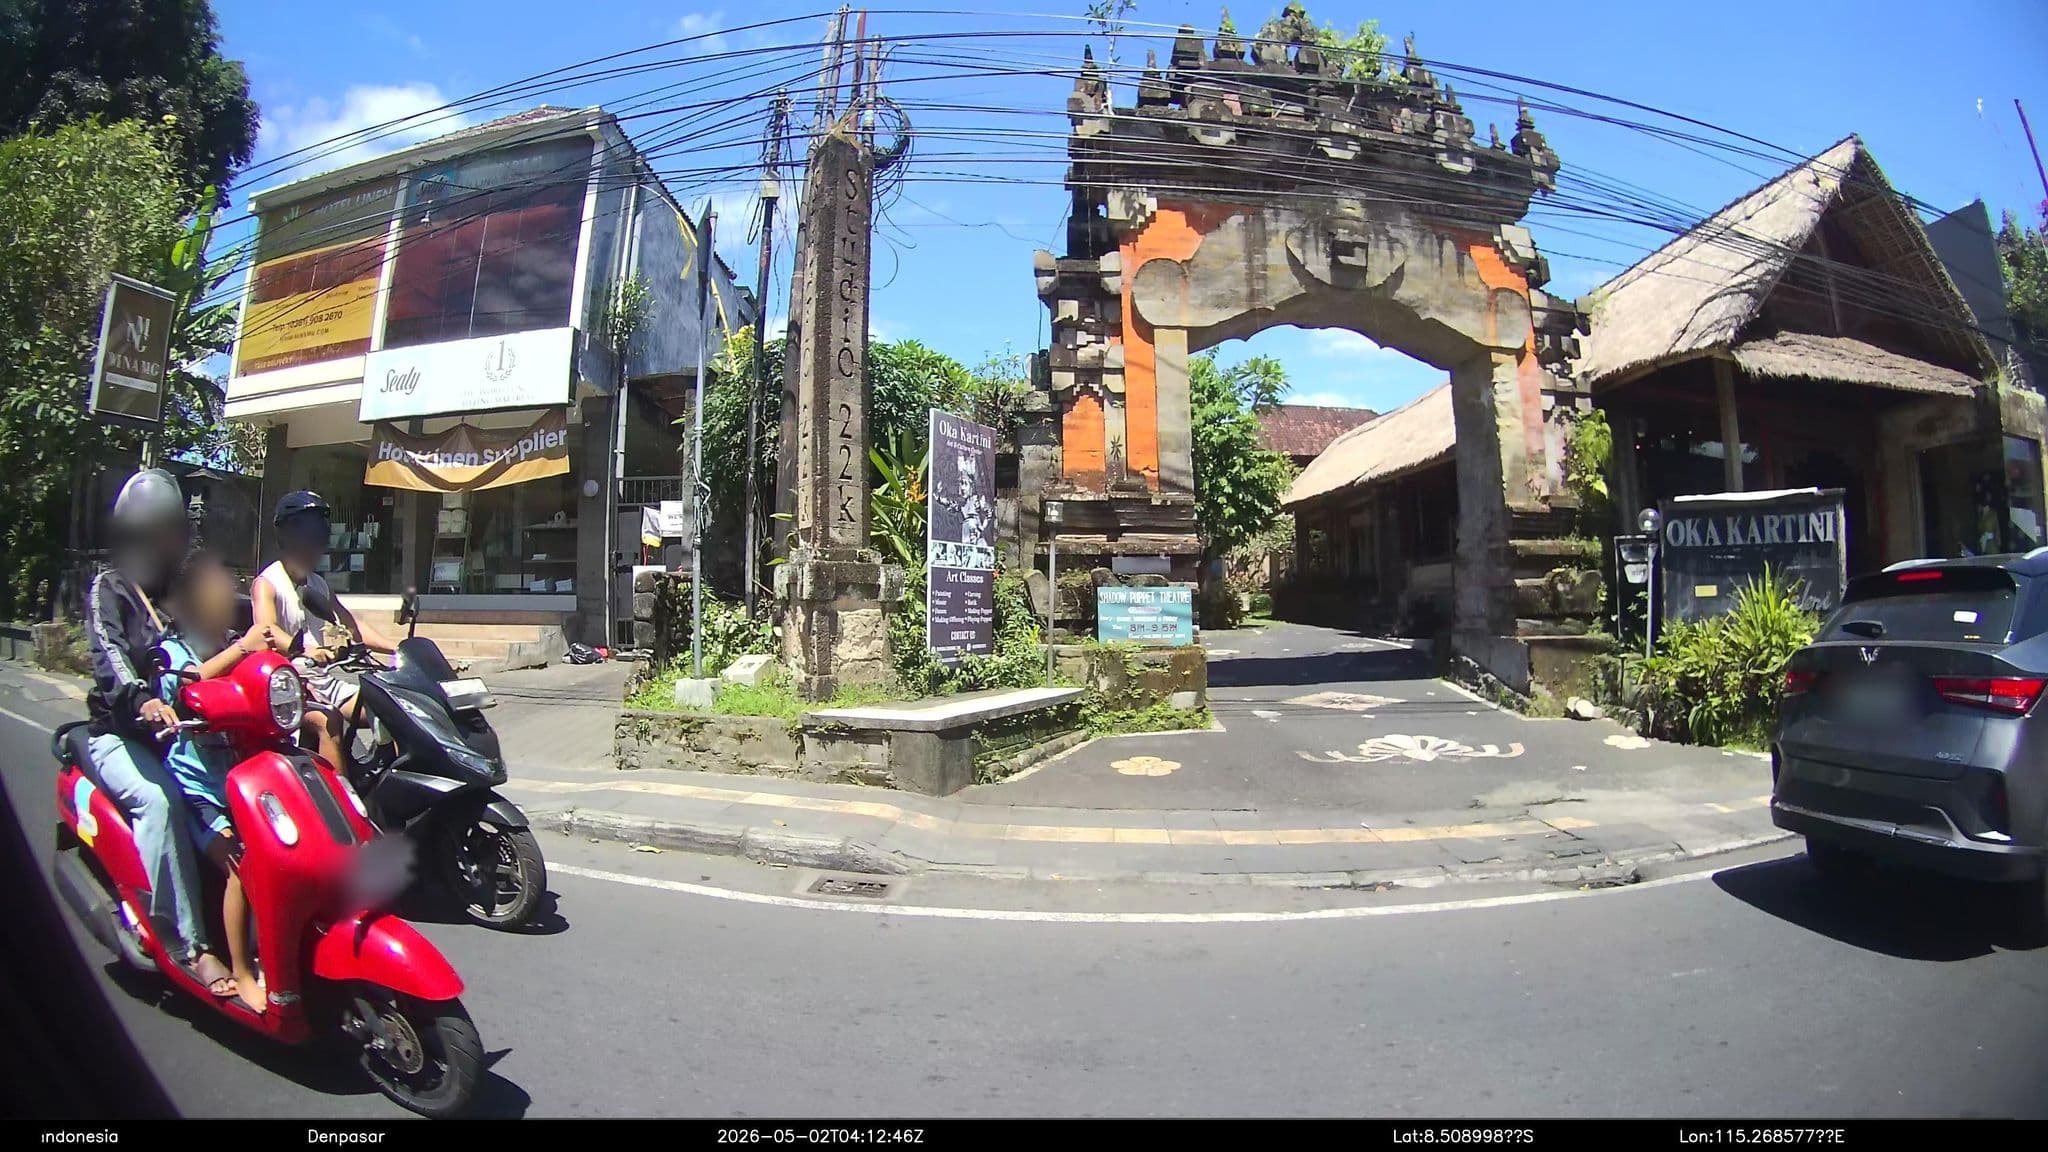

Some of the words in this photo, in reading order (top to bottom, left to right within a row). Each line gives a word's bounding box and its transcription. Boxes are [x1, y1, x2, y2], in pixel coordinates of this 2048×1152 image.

[838, 169, 858, 378] Studio
[380, 366, 421, 396] Sealy
[939, 419, 958, 439] Oka
[960, 426, 992, 449] Kartini
[837, 403, 857, 523] 22K
[1666, 516, 1722, 547] OKA
[1726, 511, 1837, 546] KARTINI
[946, 570, 958, 582] Art
[959, 571, 984, 584] Classes
[1100, 591, 1126, 604] SHADOW
[1129, 591, 1155, 604] PUPPET
[1159, 591, 1191, 604] THEATRE
